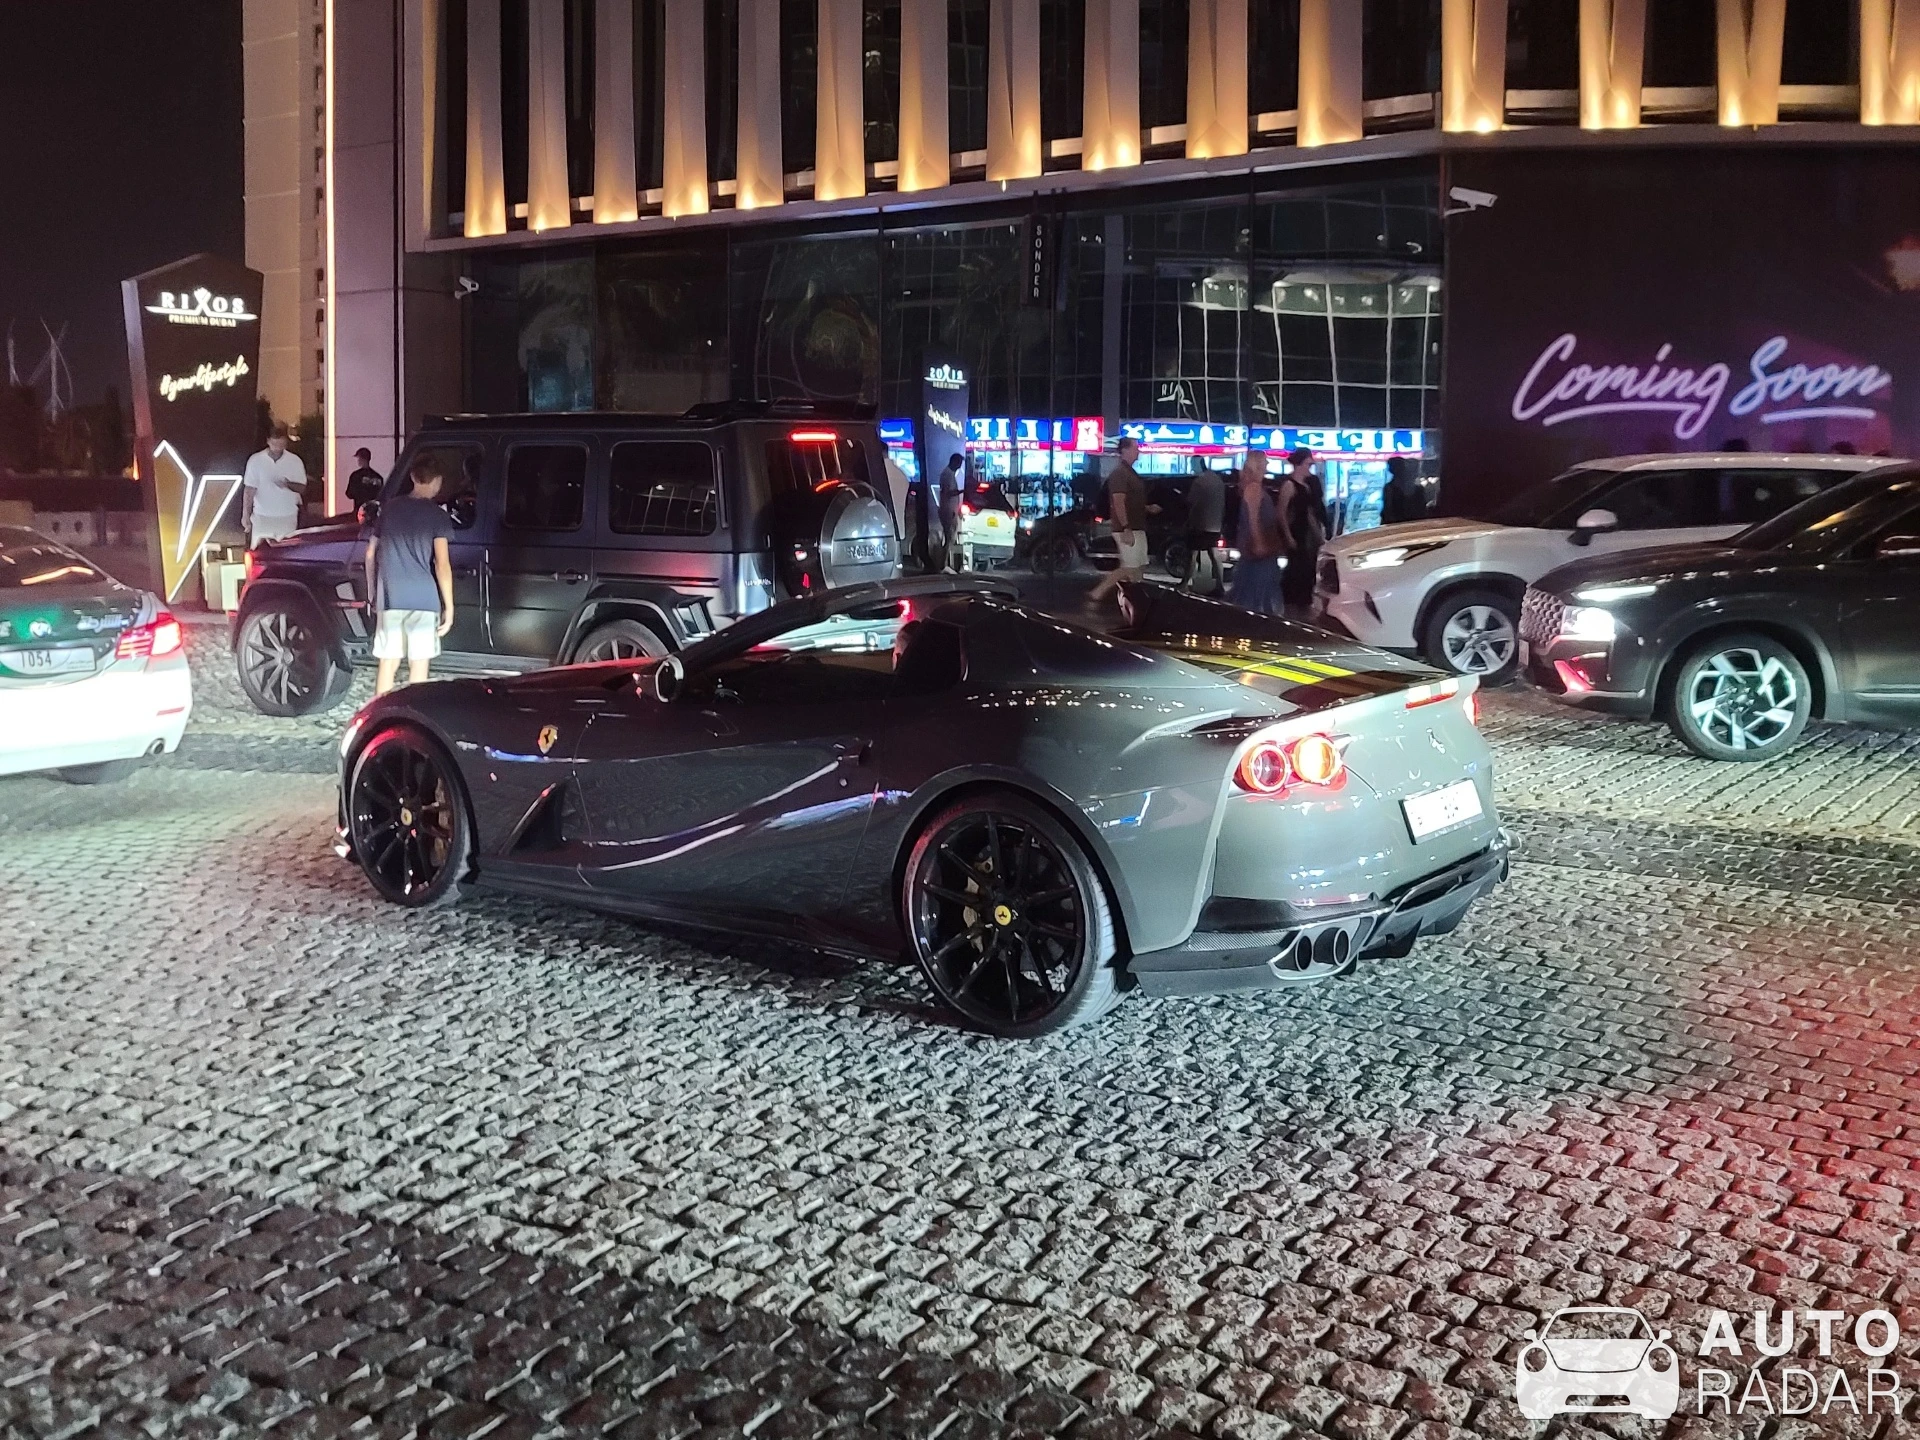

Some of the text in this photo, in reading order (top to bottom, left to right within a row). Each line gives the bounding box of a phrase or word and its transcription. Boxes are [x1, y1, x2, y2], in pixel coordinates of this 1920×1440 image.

[1033, 225, 1042, 298] SONDER
[154, 287, 250, 318] RIXOS
[168, 314, 236, 328] PREMIUM DUBAI
[1511, 333, 1892, 440] Coming Soon
[20, 651, 52, 668] 1054
